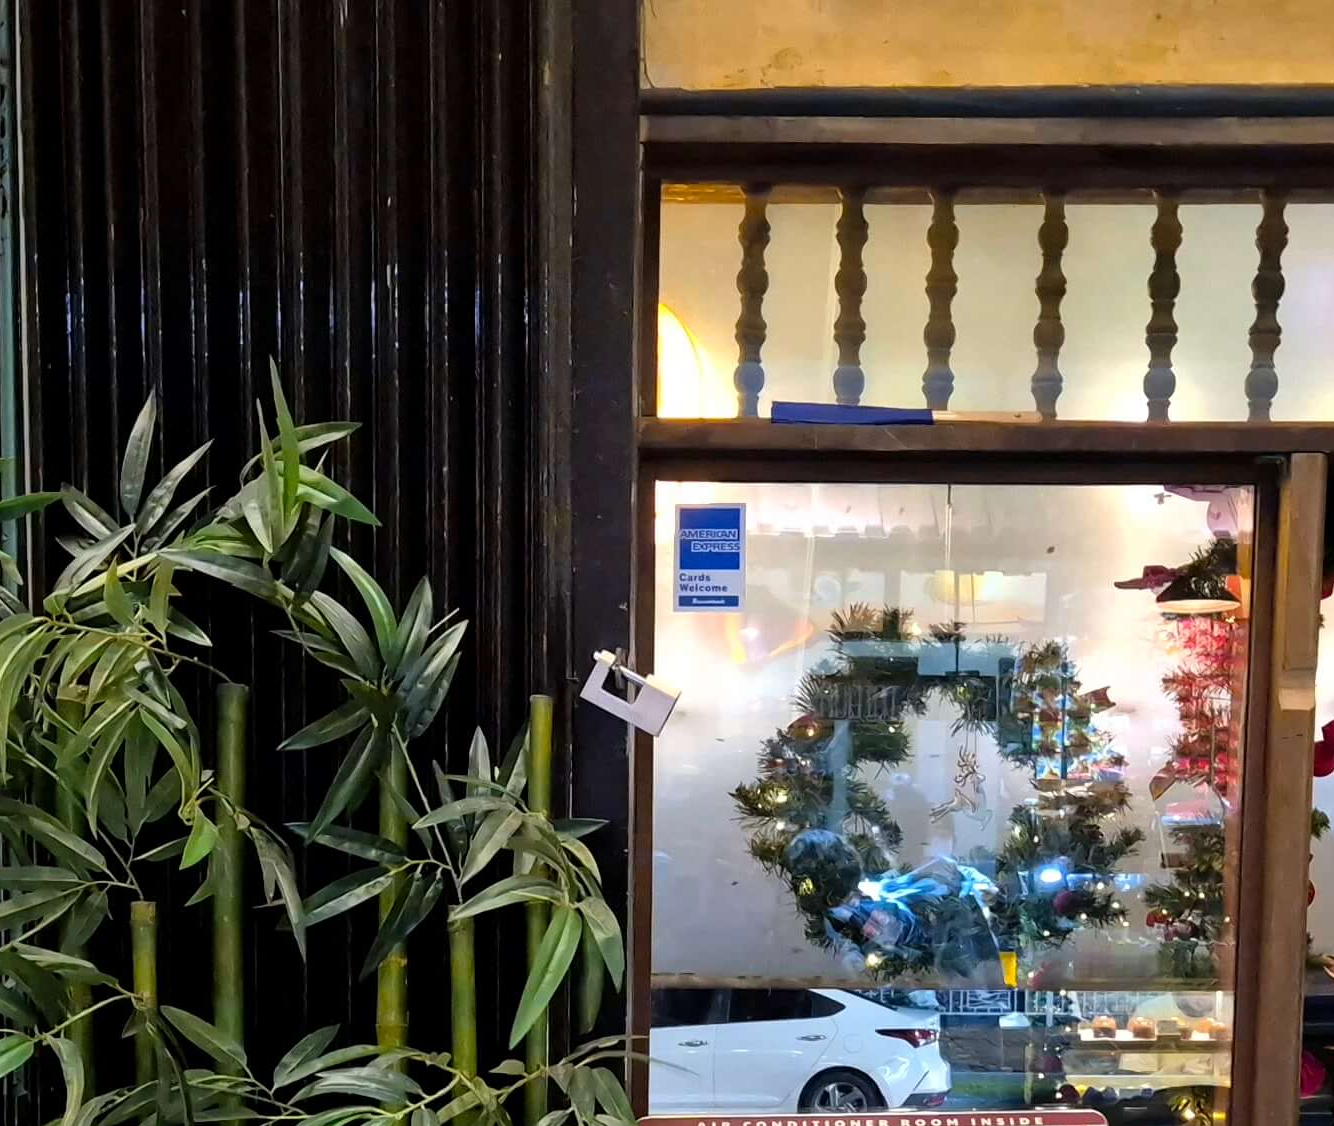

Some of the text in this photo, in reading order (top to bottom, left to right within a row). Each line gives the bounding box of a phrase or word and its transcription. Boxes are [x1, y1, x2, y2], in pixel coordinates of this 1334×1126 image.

[679, 529, 738, 539] AMERICAN
[692, 541, 741, 551] EXPRESS
[679, 573, 711, 582] Cards
[679, 583, 728, 592] Welcome
[900, 1118, 959, 1126] ROOM
[971, 1116, 1044, 1126] INSIDE
